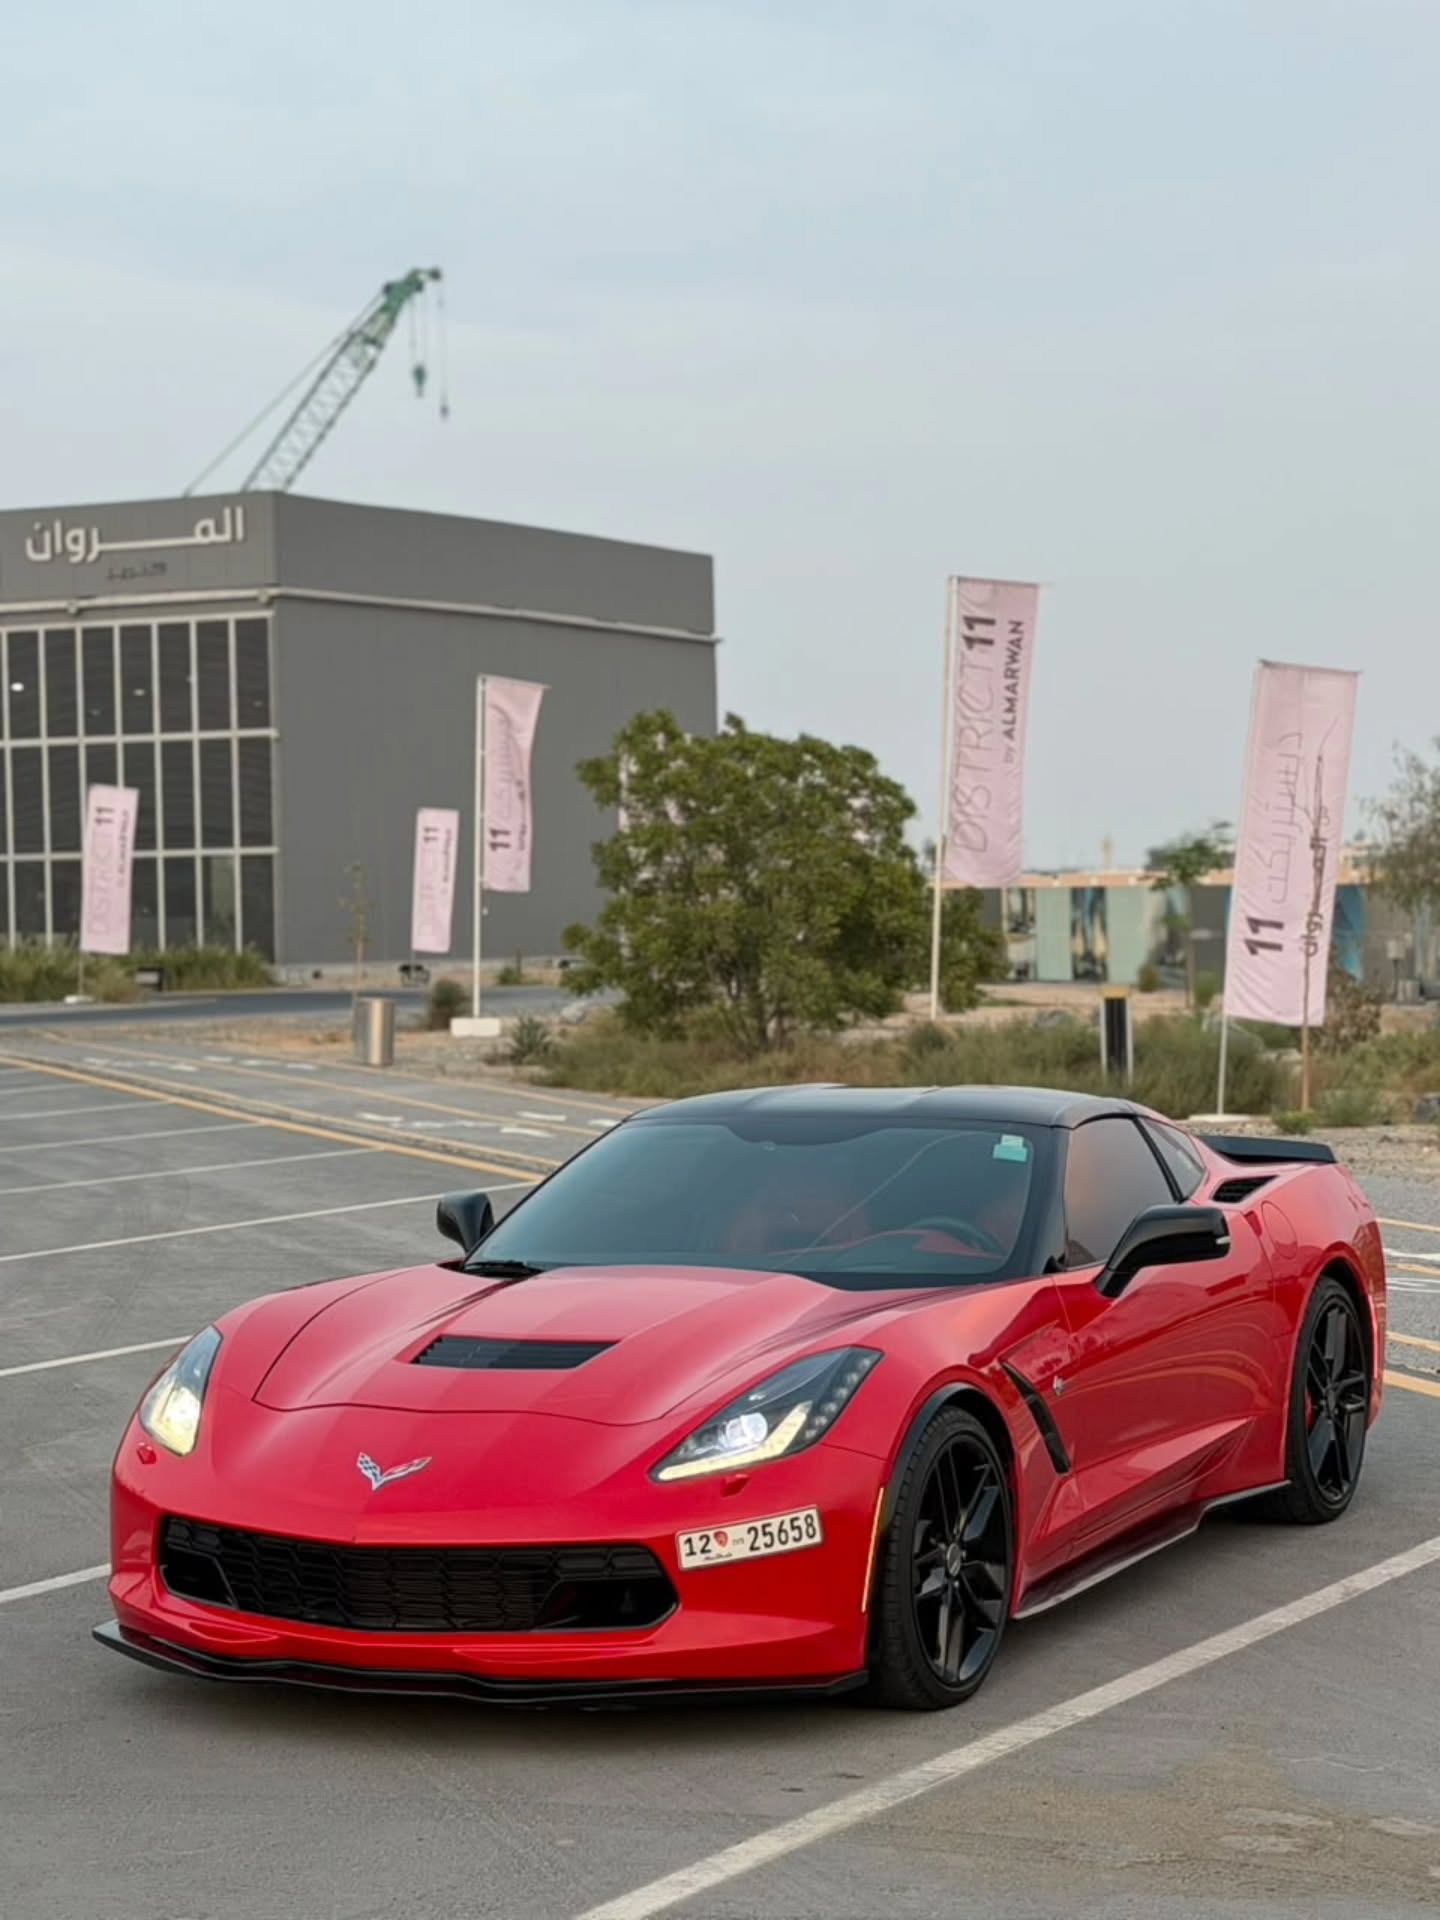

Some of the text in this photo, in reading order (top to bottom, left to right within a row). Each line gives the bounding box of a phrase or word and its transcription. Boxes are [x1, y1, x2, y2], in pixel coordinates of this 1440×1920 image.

[25, 506, 244, 564] المروان
[1002, 619, 1024, 741] ALMARWAN
[954, 614, 997, 852] DISTRICT 11
[489, 828, 512, 851] 11
[1244, 915, 1285, 957] 11
[684, 1513, 817, 1557] 12 25658
